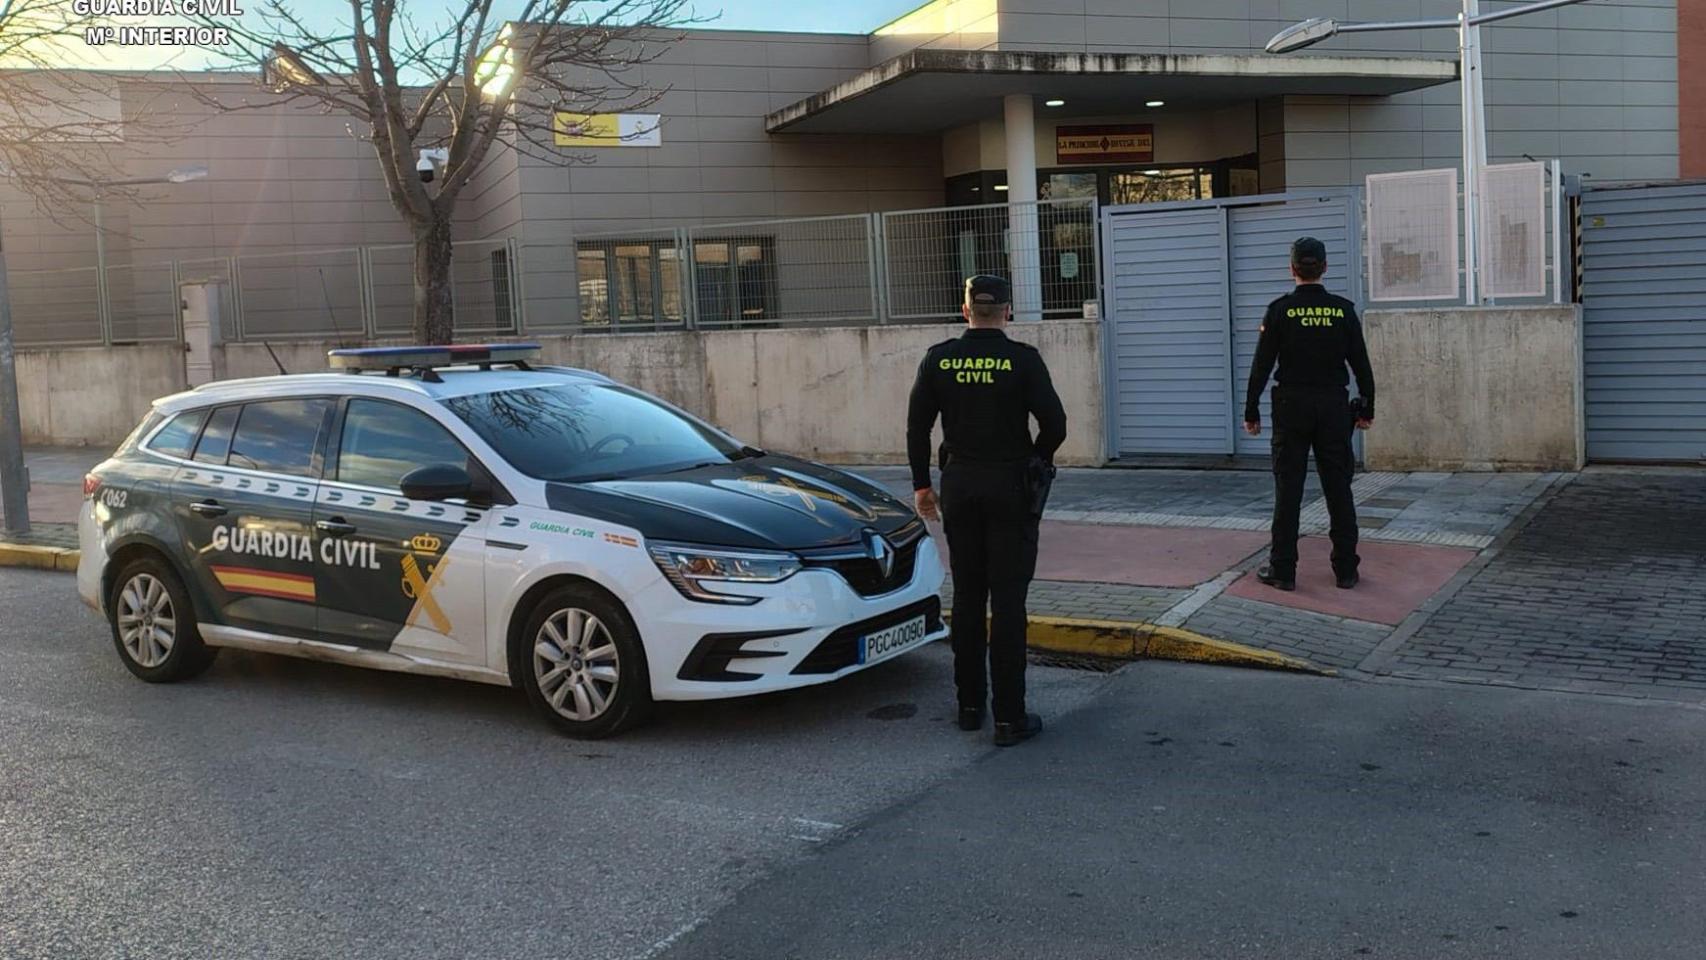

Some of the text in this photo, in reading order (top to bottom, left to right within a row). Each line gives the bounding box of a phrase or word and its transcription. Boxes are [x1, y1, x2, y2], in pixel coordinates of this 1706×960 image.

[1287, 307, 1344, 318] GUARDIA
[1300, 317, 1333, 326] CIVIL
[939, 358, 1012, 370] GUARDIA
[956, 370, 995, 383] CIVIL
[107, 488, 127, 508] 062
[529, 521, 596, 539] GUARDIA CIVIL
[212, 524, 381, 571] GUARDIA CIVIL
[867, 620, 923, 658] PGC4009G
